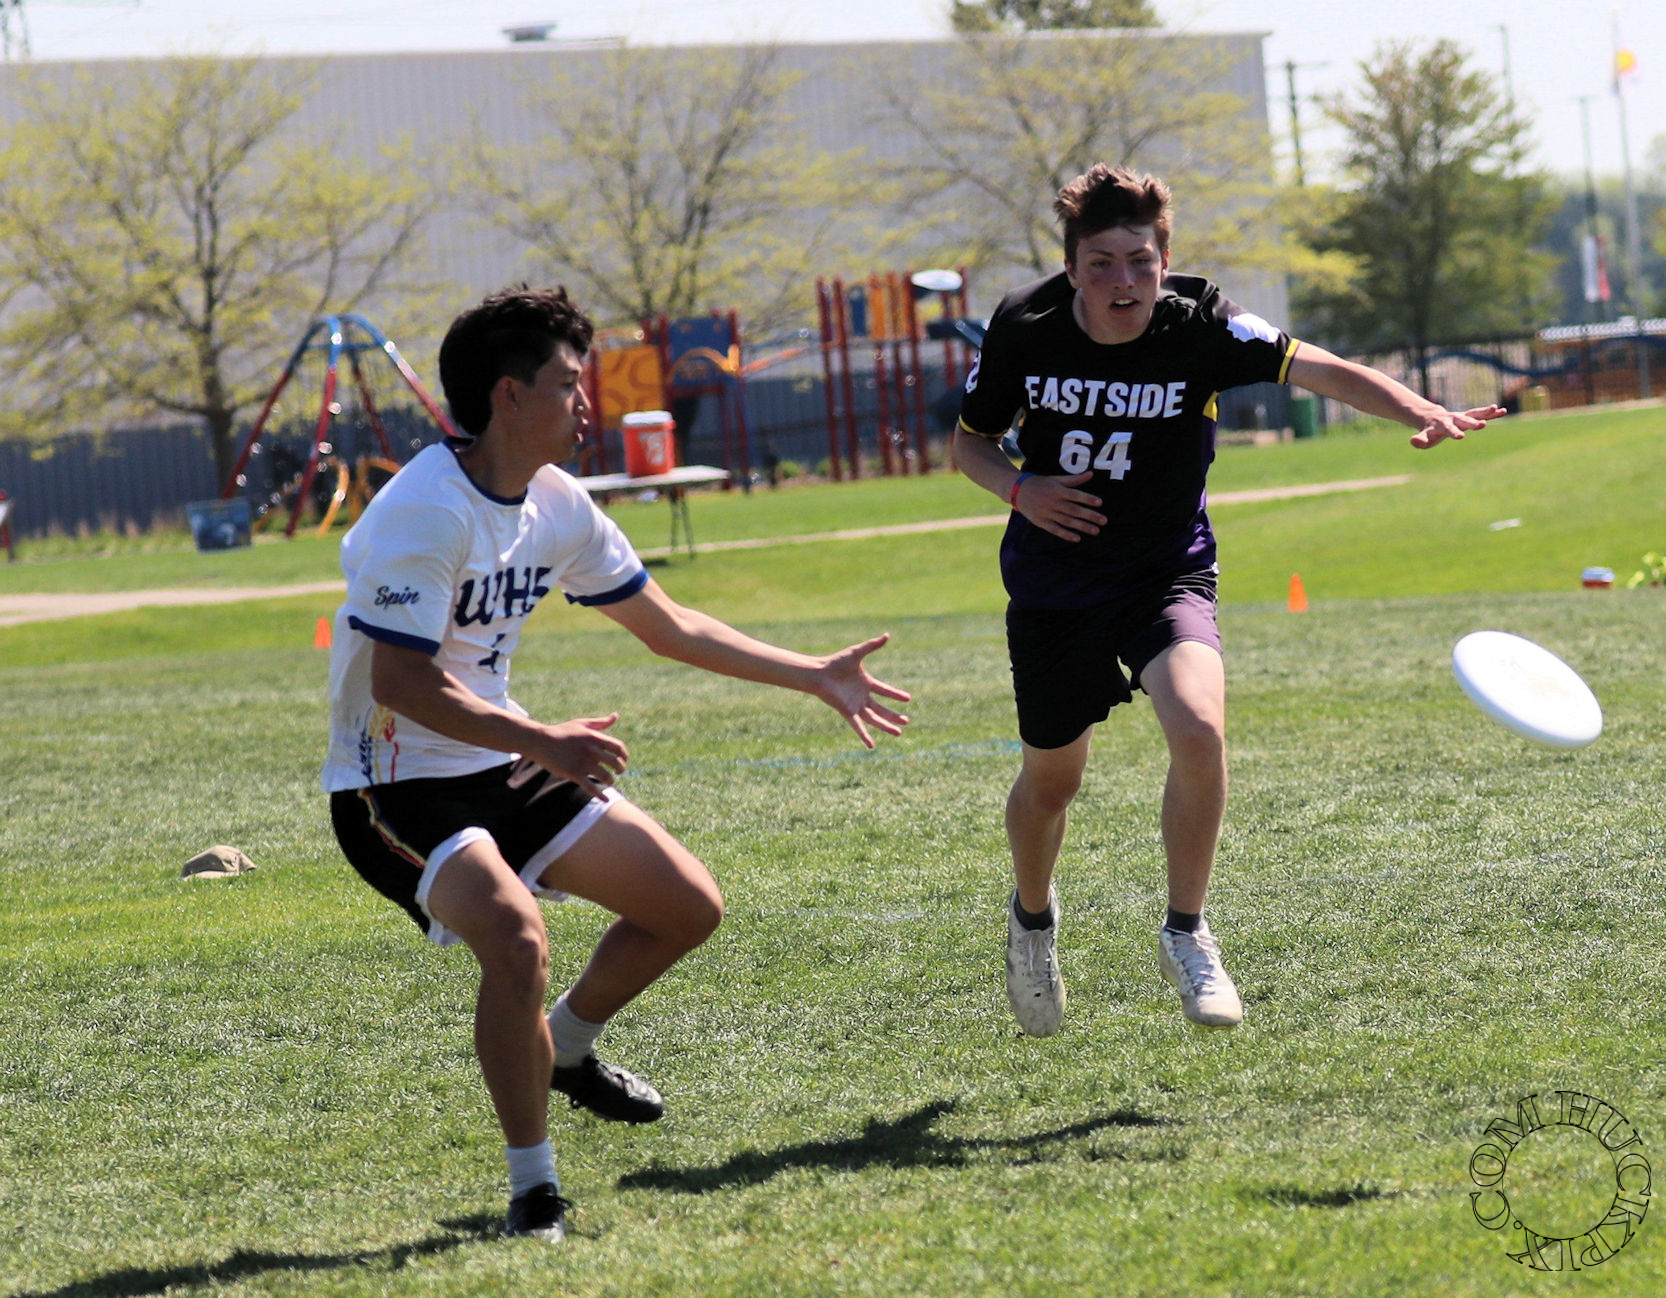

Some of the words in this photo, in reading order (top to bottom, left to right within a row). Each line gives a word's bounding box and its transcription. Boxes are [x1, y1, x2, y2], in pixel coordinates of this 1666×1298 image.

[1025, 376, 1187, 419] EASTSIDE
[1058, 429, 1133, 481] 64
[374, 585, 421, 609] Spin
